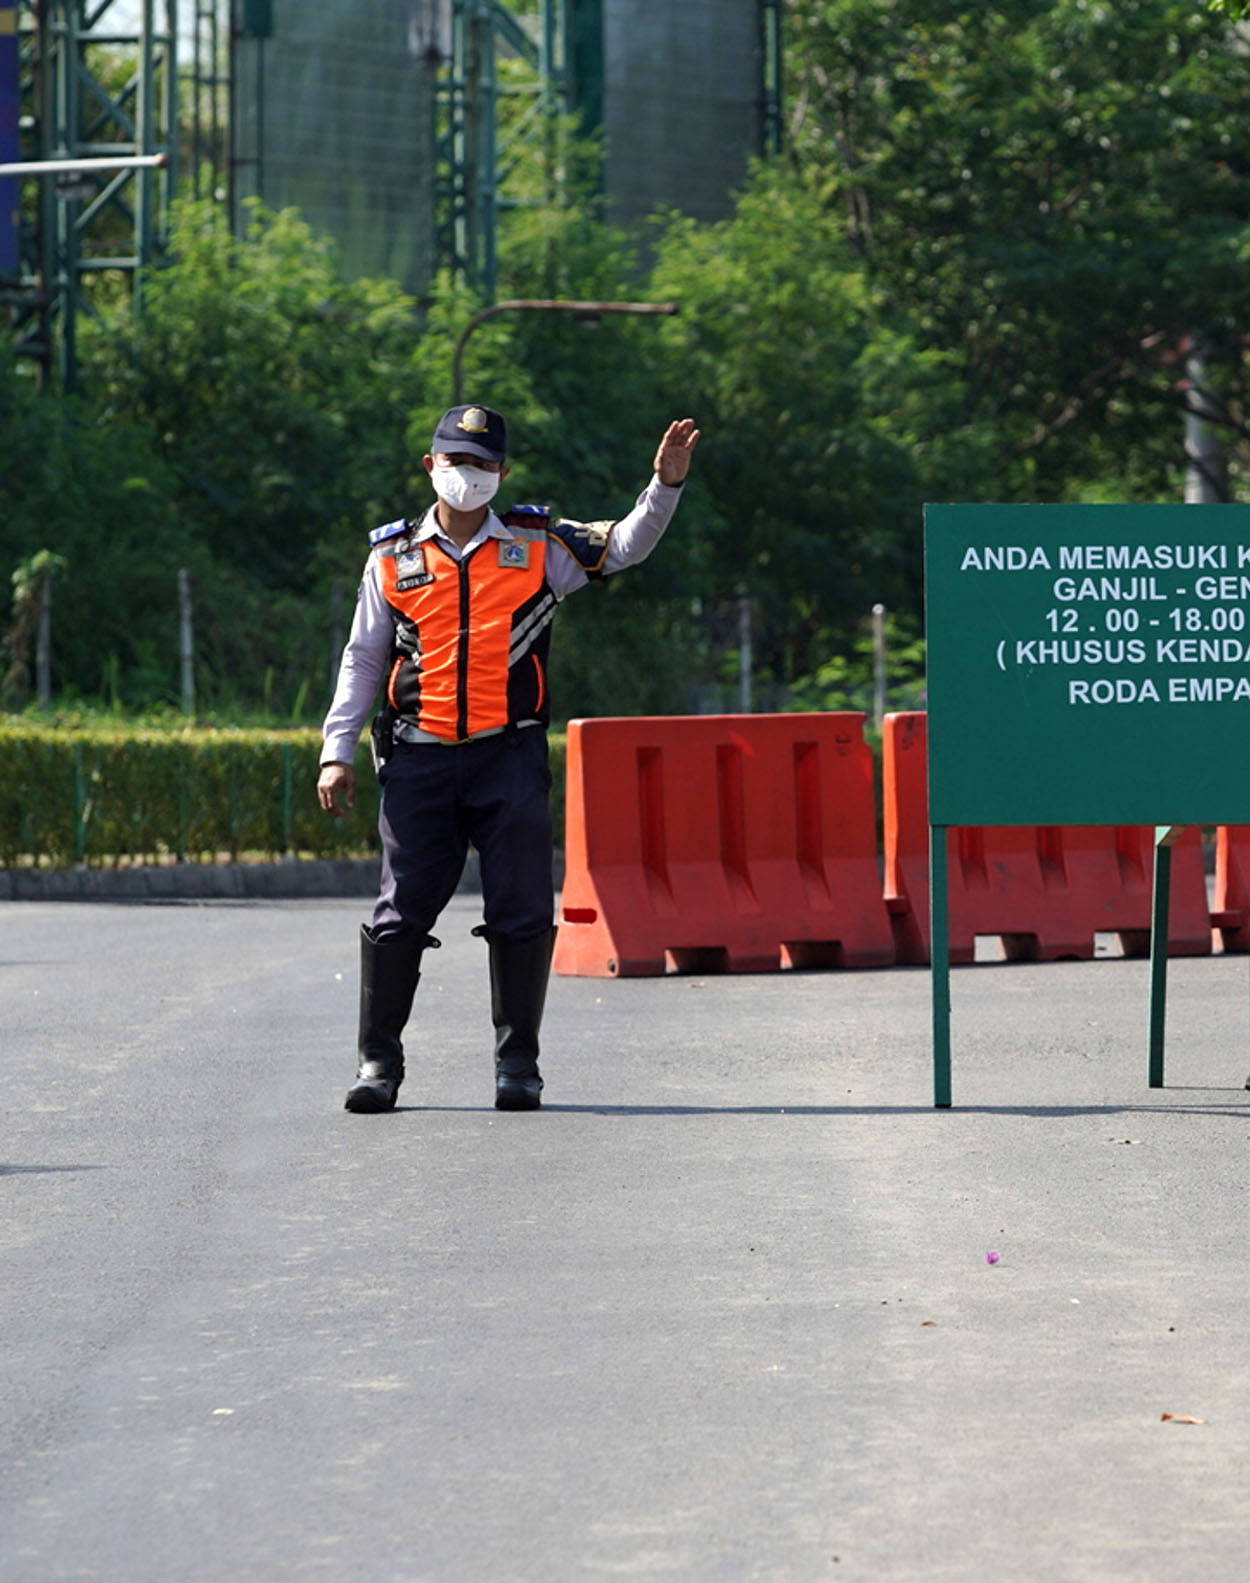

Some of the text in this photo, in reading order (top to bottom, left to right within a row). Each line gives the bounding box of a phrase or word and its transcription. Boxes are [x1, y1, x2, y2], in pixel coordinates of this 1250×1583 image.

[960, 546, 1051, 571] ANDA
[1059, 545, 1227, 570] MEMASUKI
[1053, 577, 1167, 601] GANJIL
[1169, 607, 1245, 632] 18.00
[1016, 639, 1146, 664] KHUSUS
[1069, 679, 1161, 704] RODA
